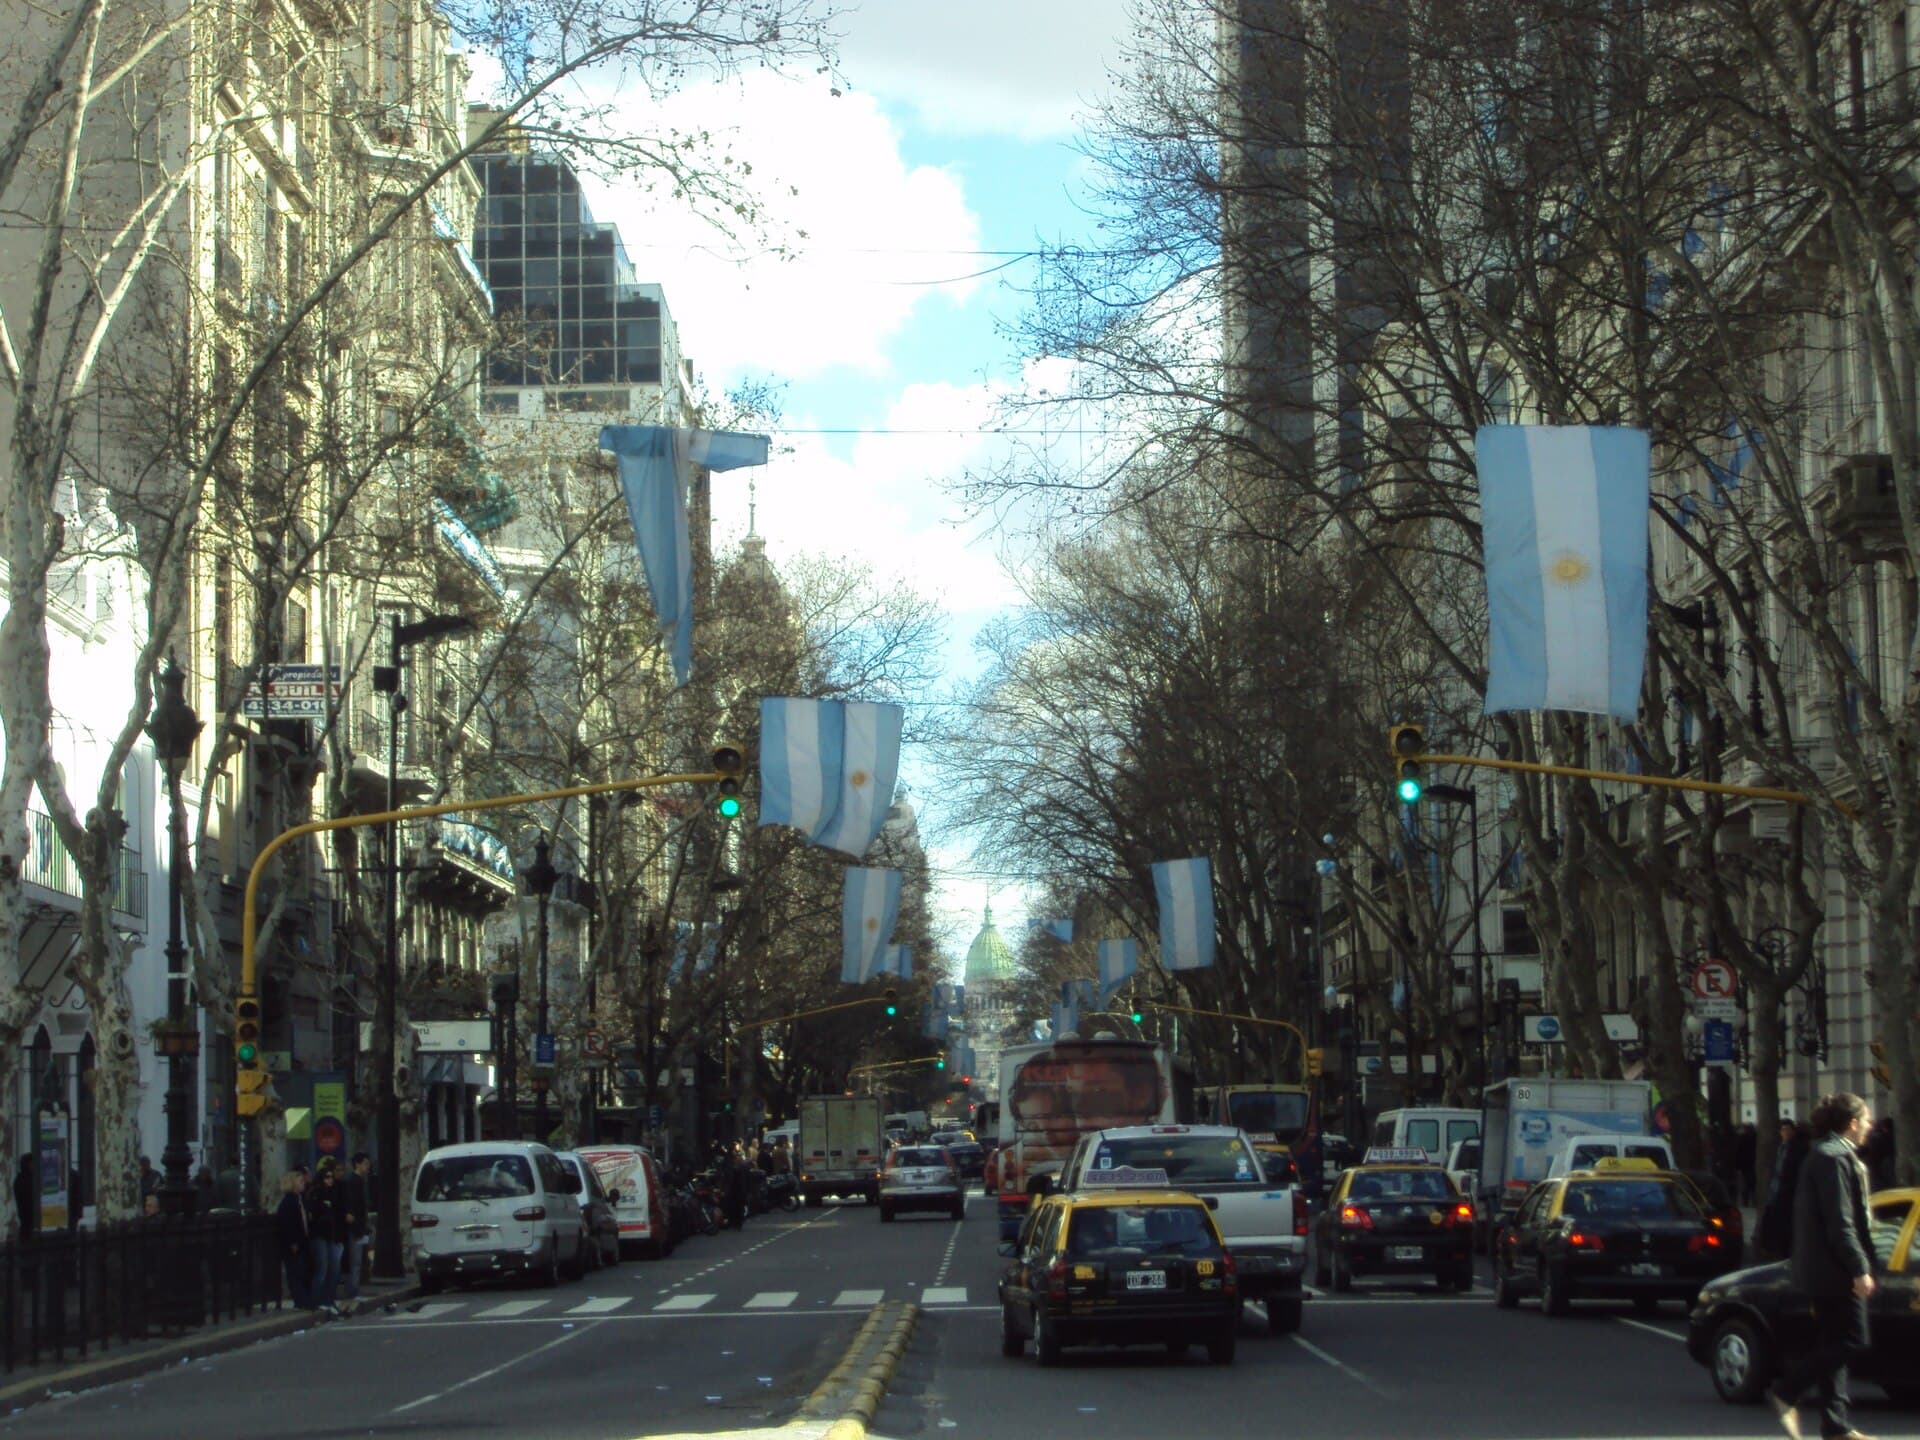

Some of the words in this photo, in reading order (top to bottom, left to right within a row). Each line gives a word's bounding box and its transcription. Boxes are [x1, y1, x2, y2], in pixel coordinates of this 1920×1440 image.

[282, 668, 337, 681] propiedas
[1706, 969, 1721, 992] E
[1518, 1089, 1531, 1100] 80
